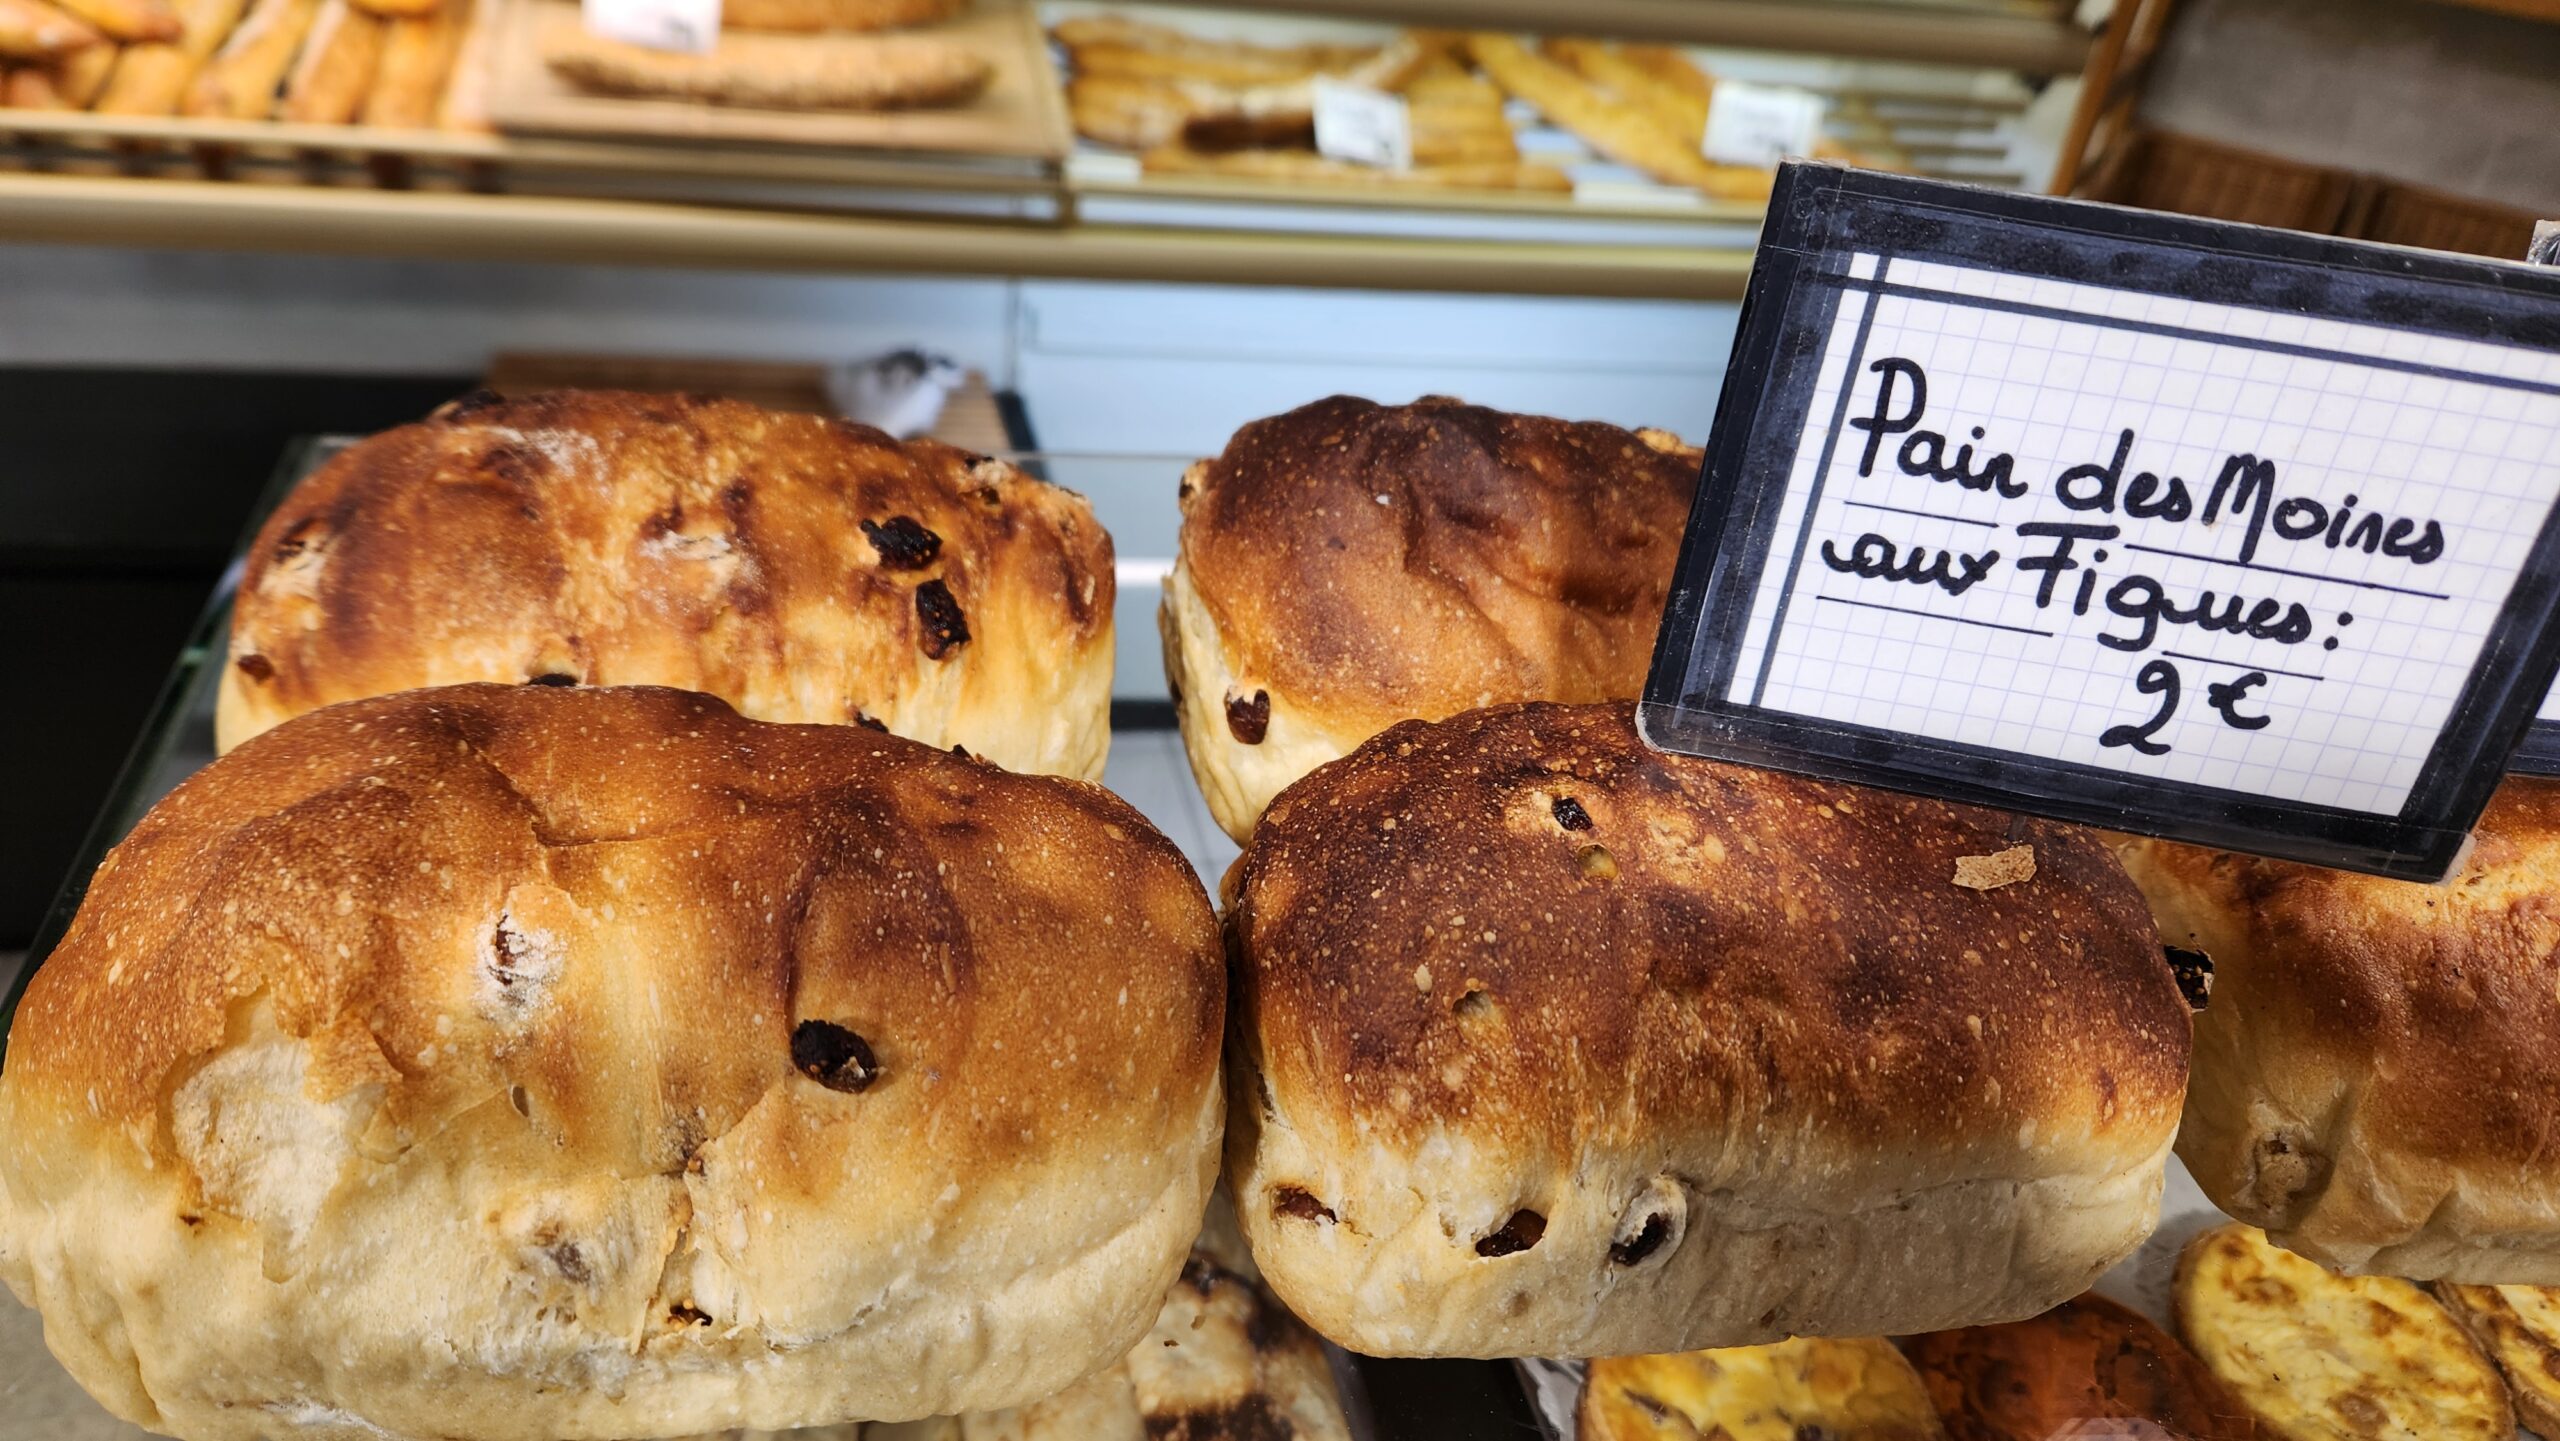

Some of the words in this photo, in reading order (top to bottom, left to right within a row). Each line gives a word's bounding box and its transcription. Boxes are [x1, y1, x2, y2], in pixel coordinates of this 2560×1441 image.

[1849, 357, 2029, 499] Pain
[2055, 428, 2193, 523] des
[2203, 453, 2446, 565] Moines
[1821, 532, 2000, 597] aux
[2016, 522, 2354, 652] Figues:
